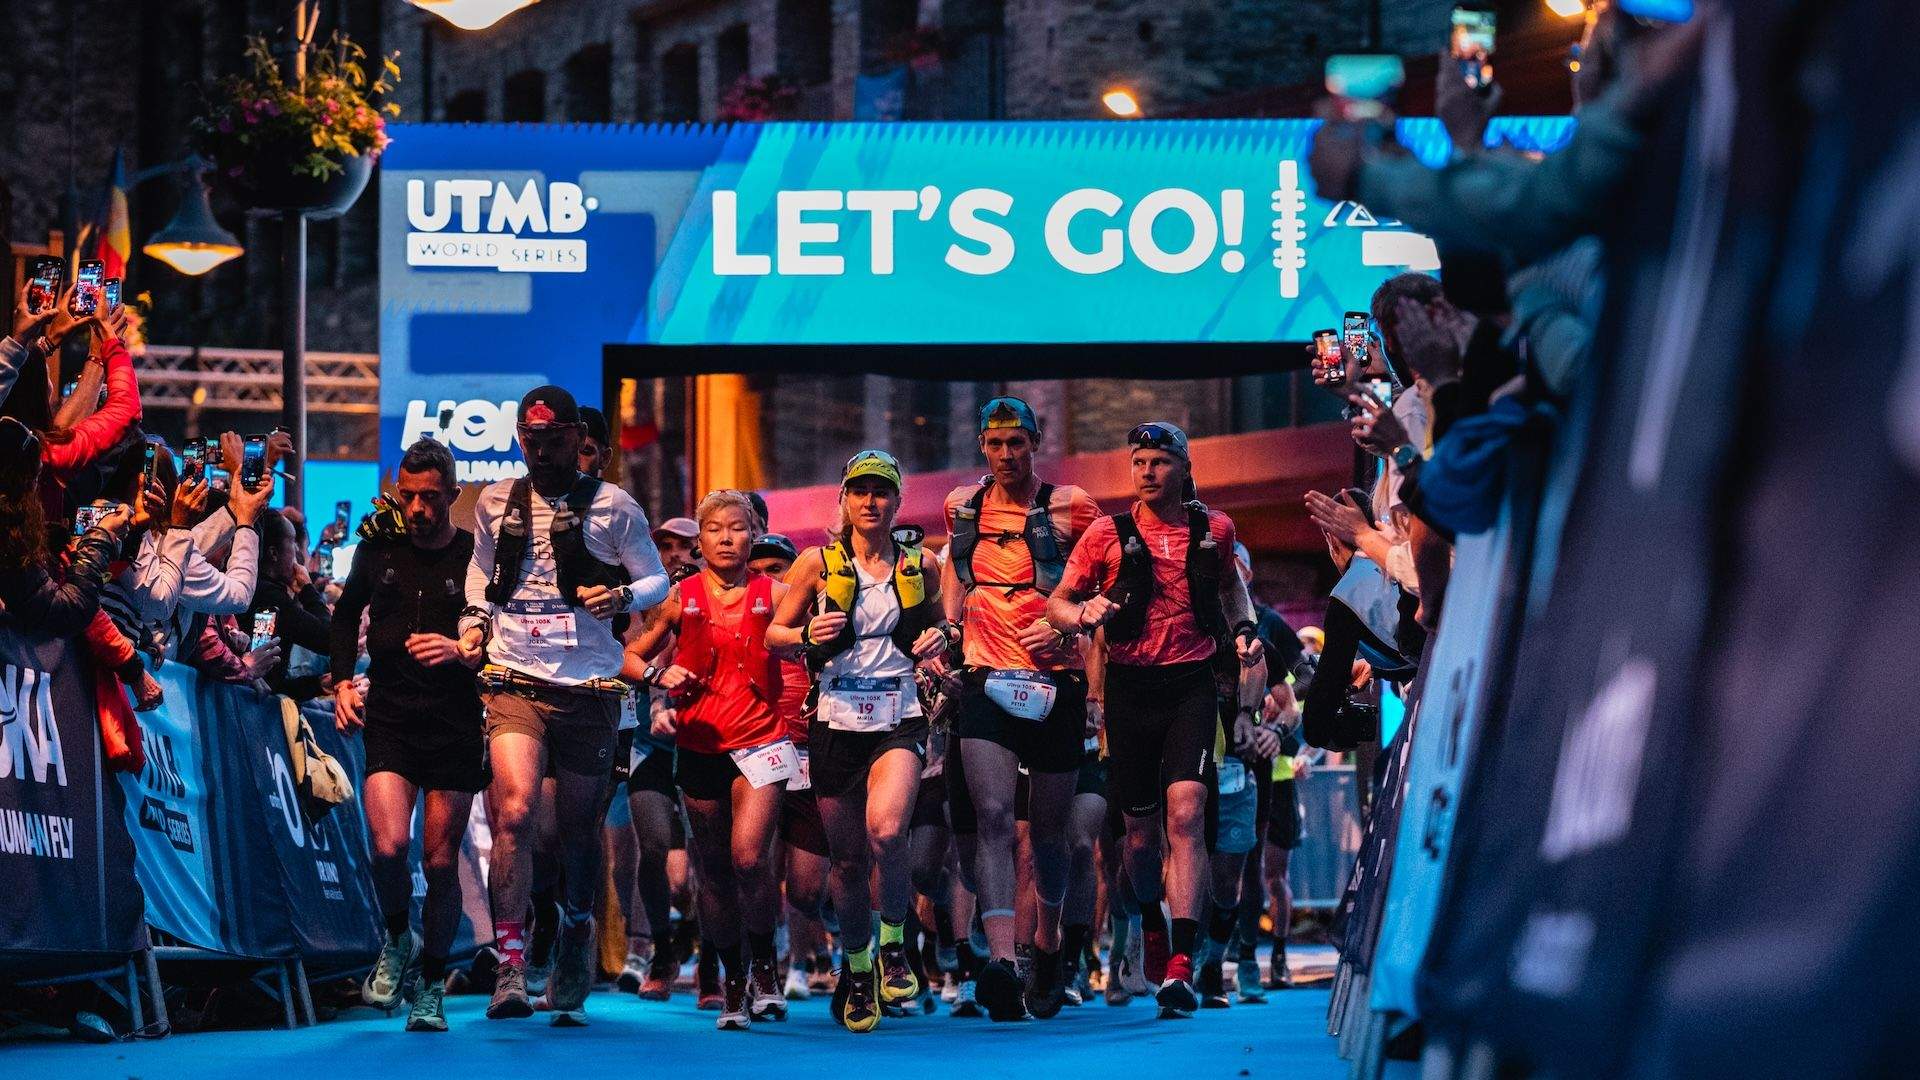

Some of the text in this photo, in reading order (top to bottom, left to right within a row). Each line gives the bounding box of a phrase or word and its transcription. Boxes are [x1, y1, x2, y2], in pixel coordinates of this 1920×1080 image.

[407, 179, 587, 234] UTMB
[712, 185, 1245, 275] LET'S GO!
[419, 242, 577, 263] WORLD SERIES
[401, 399, 521, 452] HOK
[531, 626, 541, 638] 6
[1013, 689, 1029, 701] 10
[858, 702, 874, 714] 19
[767, 754, 782, 767] 21
